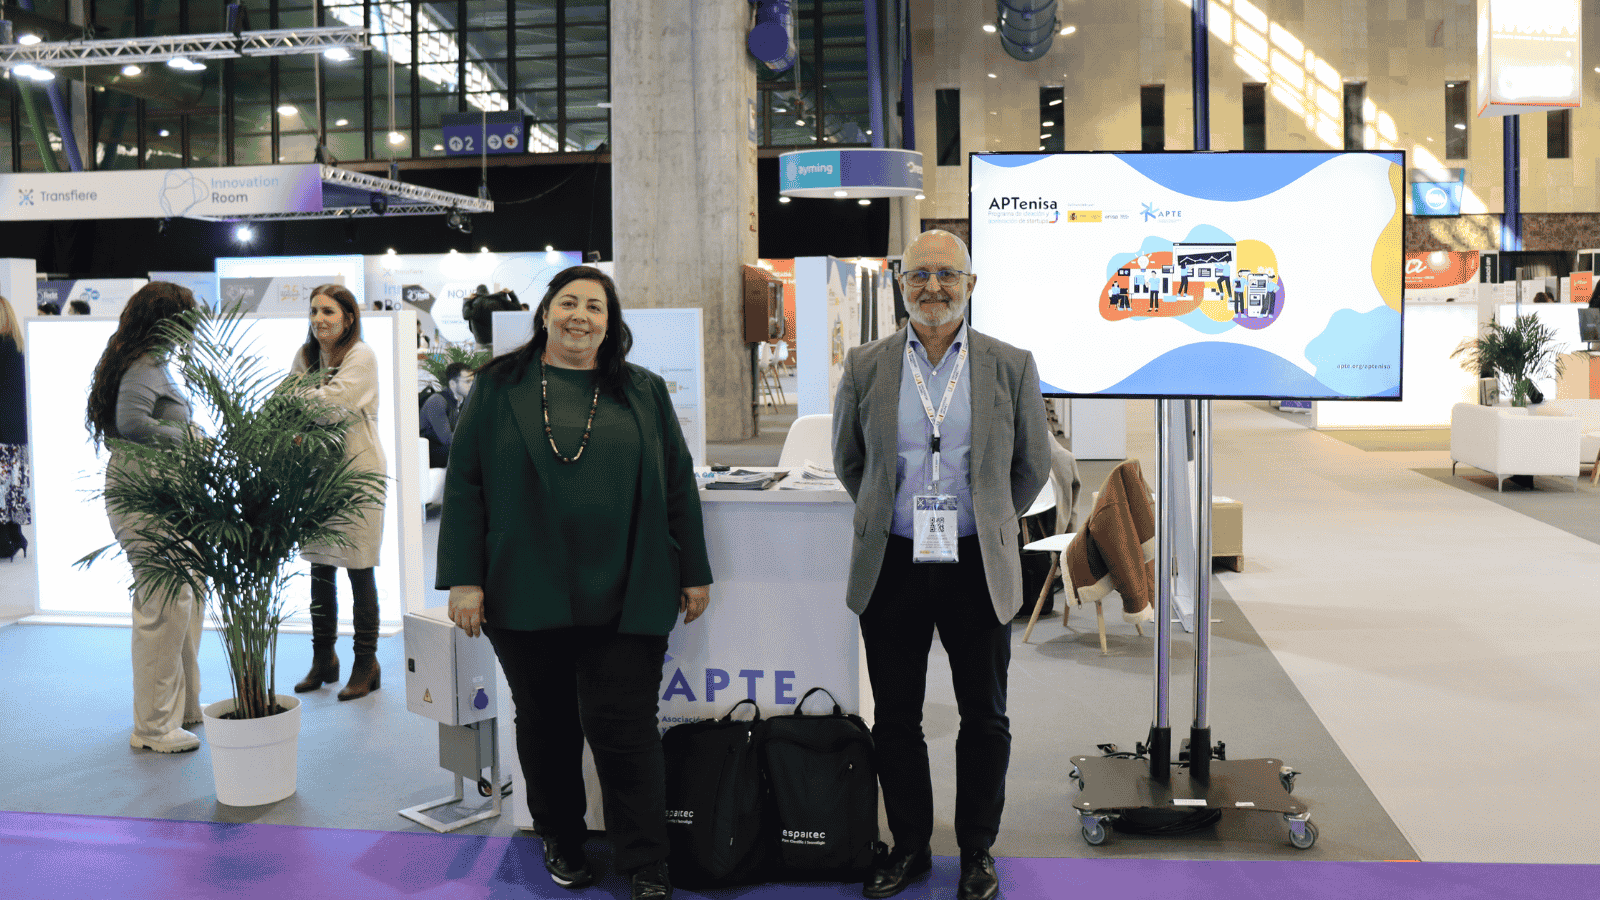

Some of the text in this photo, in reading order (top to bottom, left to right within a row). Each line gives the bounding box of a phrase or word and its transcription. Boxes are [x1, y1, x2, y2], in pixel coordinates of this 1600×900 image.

[465, 135, 474, 151] 2
[798, 163, 833, 176] ayming
[211, 176, 279, 189] Innovation
[40, 190, 98, 202] Transfiere
[211, 192, 249, 204] Room
[988, 196, 1058, 210] APTenisa
[1158, 210, 1182, 218] APTE
[661, 667, 798, 705] APTE
[782, 829, 826, 840] espaitec
